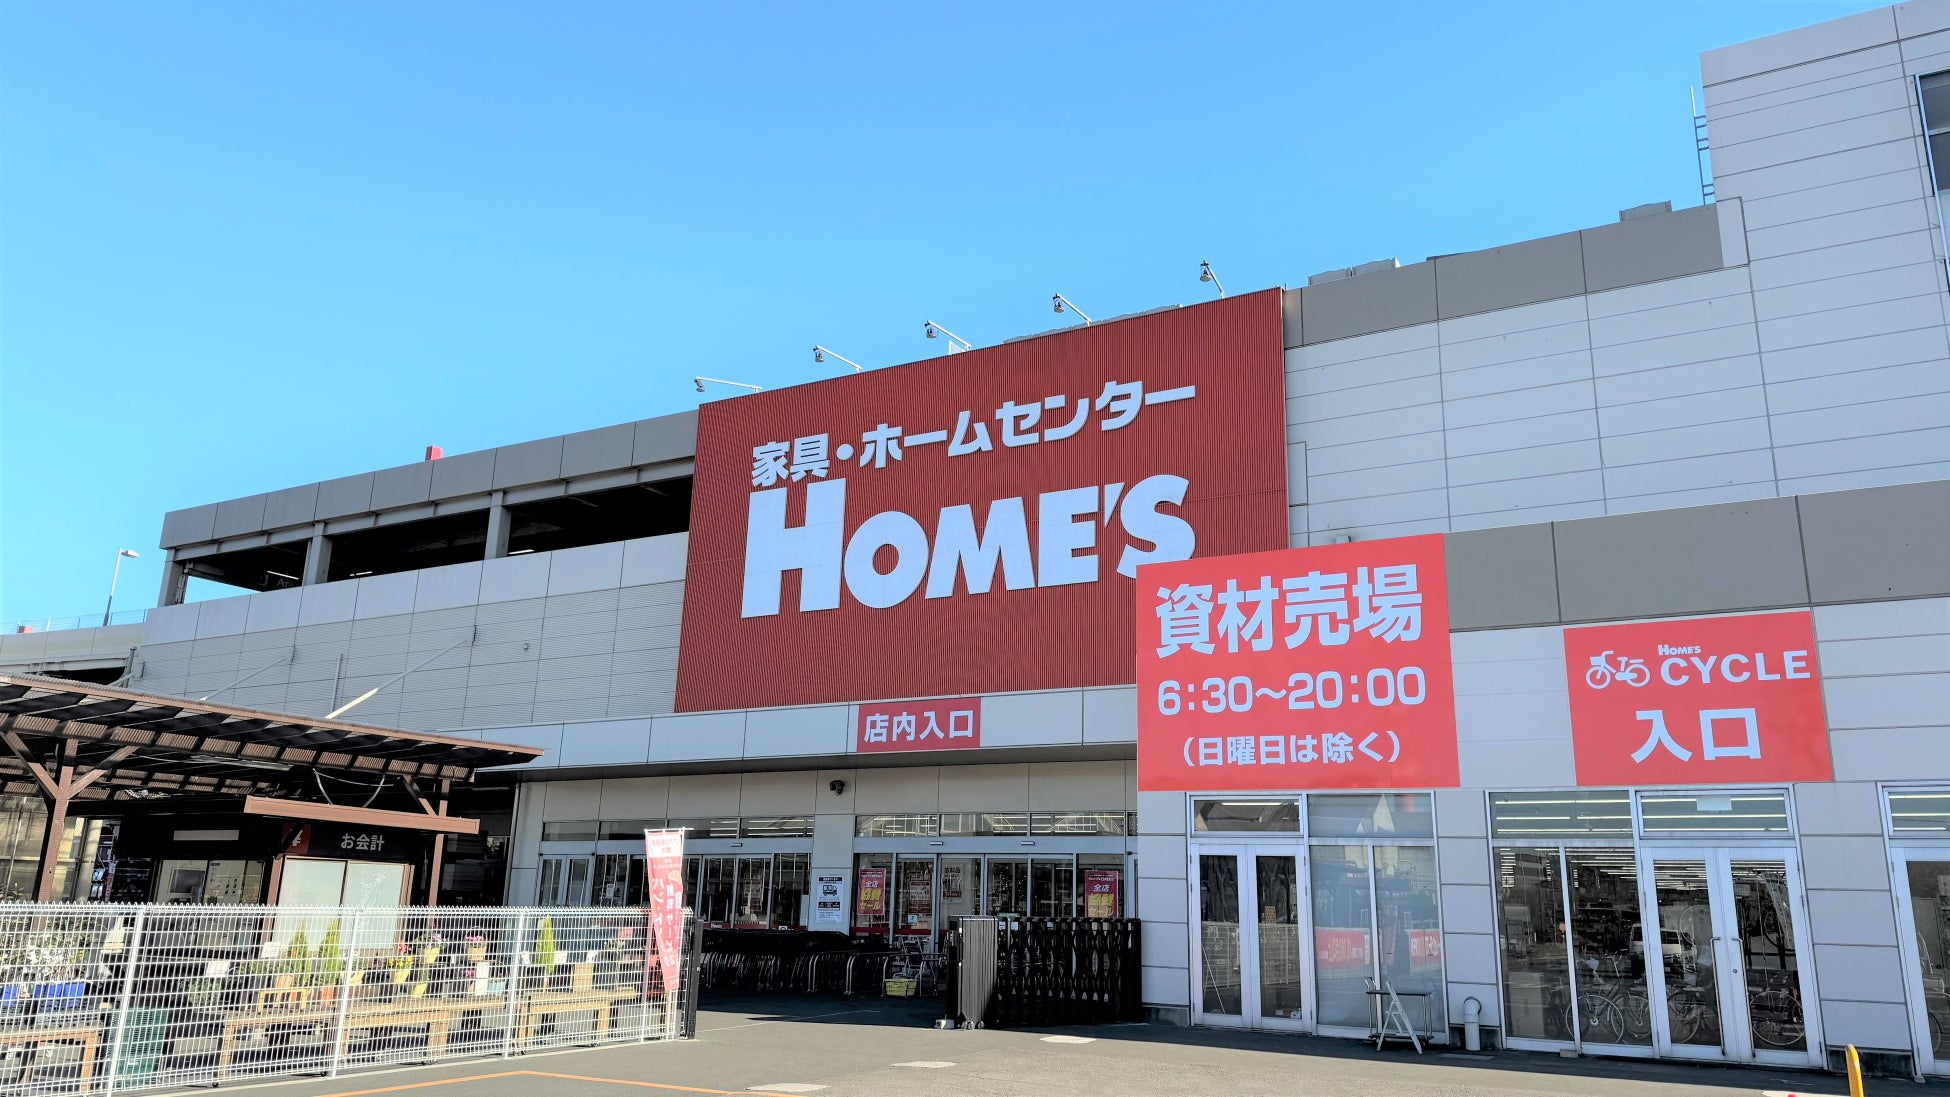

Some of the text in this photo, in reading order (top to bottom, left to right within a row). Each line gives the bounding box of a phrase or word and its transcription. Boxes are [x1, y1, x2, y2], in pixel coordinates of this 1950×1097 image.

[751, 379, 1196, 487] 家具・ホームセンター
[1156, 563, 1424, 659] 資材売場
[1660, 650, 1811, 686] CYCLE
[863, 709, 974, 743] 店内入口
[1630, 707, 1762, 763] 入口
[341, 833, 385, 851] お会計
[1093, 883, 1111, 892] 全店
